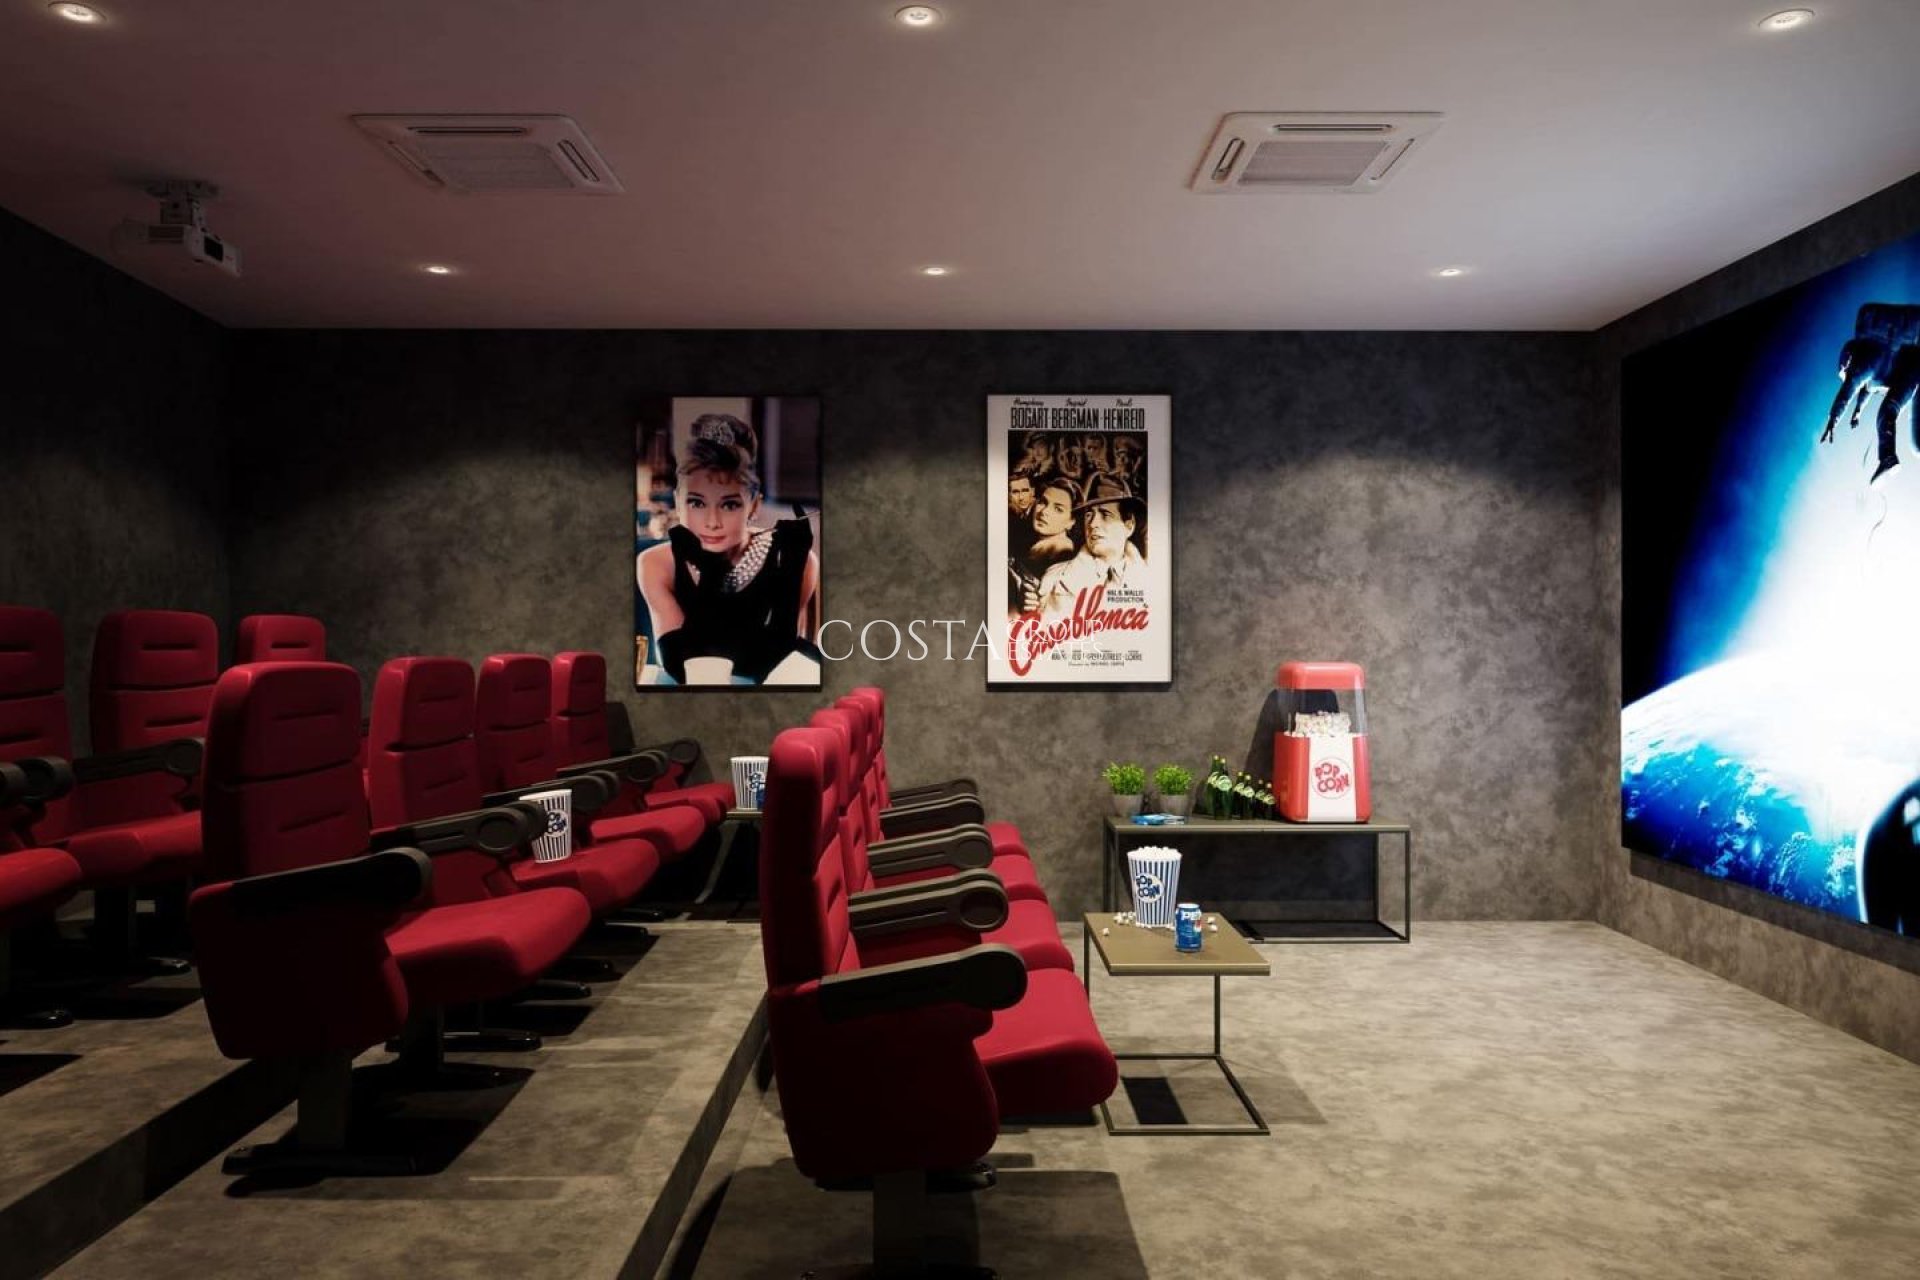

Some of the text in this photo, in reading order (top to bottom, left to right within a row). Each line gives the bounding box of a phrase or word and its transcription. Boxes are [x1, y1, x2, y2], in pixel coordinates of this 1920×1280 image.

[1010, 407, 1145, 430] BOGART BERGMAN HENREID
[1315, 762, 1340, 780] POP
[1317, 773, 1350, 793] CORN
